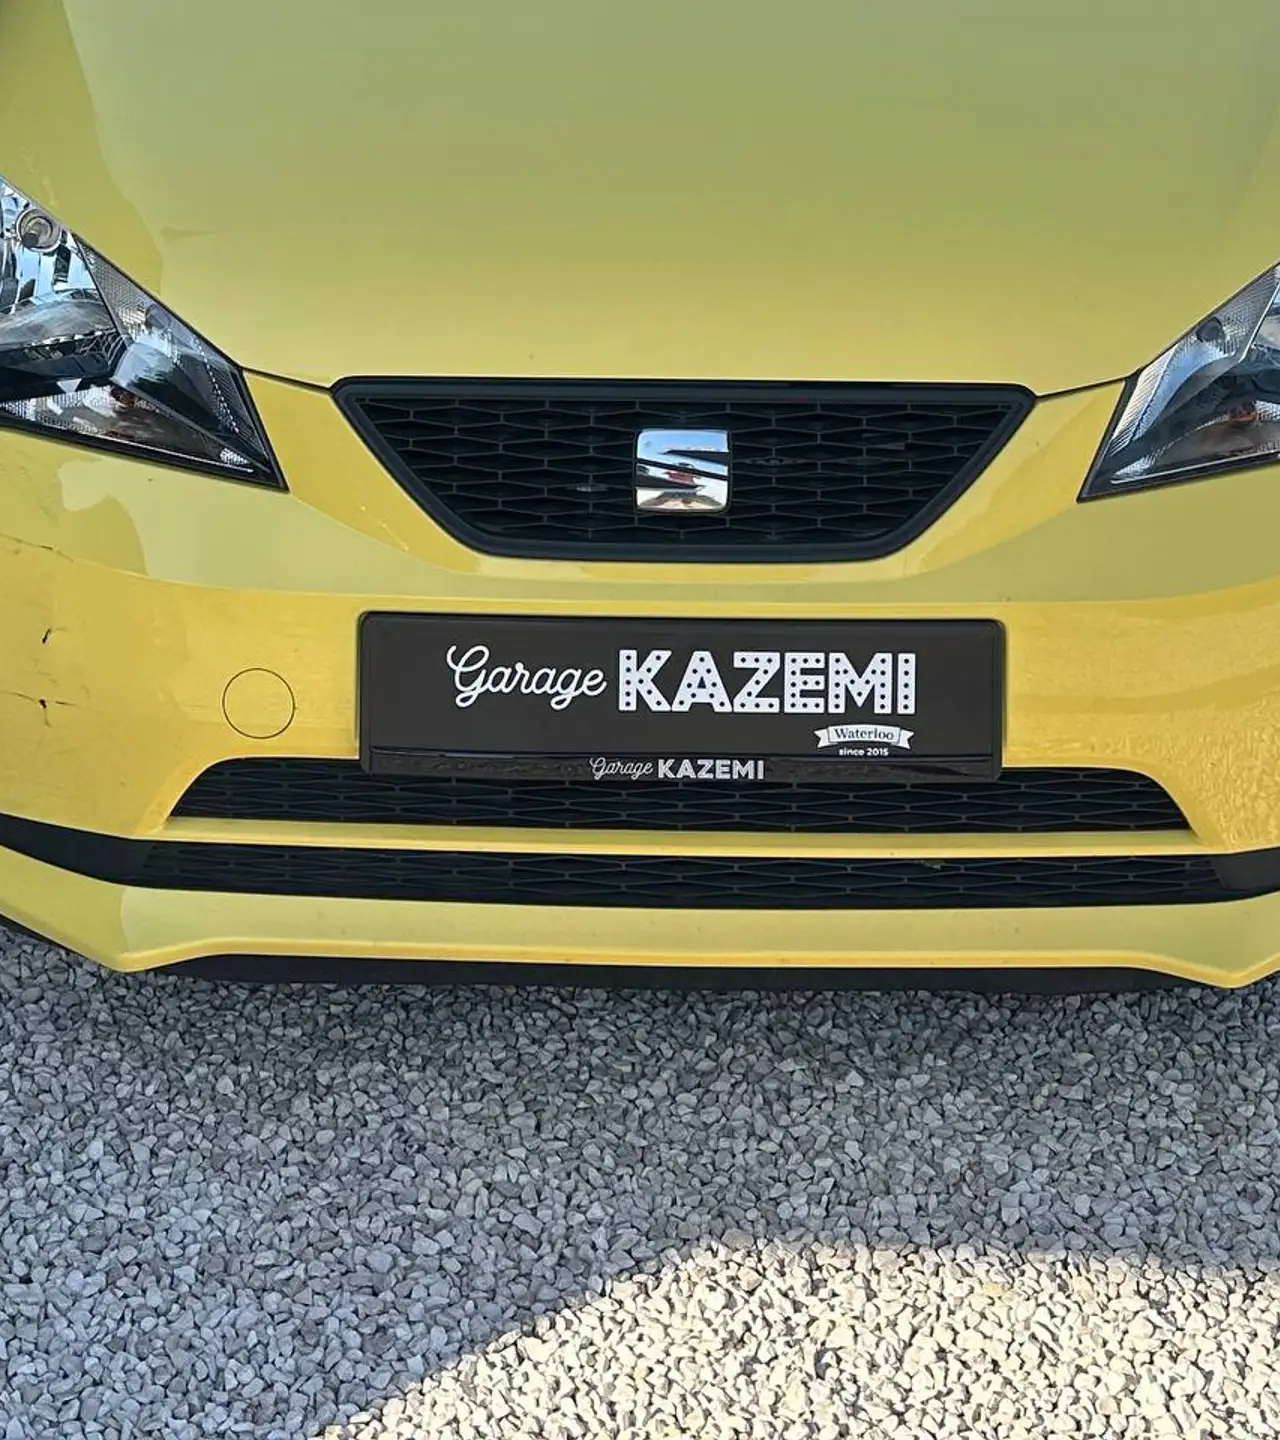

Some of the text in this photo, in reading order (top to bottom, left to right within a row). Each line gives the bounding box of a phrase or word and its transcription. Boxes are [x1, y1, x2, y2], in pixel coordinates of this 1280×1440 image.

[446, 645, 916, 714] Garage KAZEMI
[834, 728, 895, 740] Waterloo
[839, 748, 889, 756] since 2015
[589, 757, 765, 780] Garage KAZEMI
